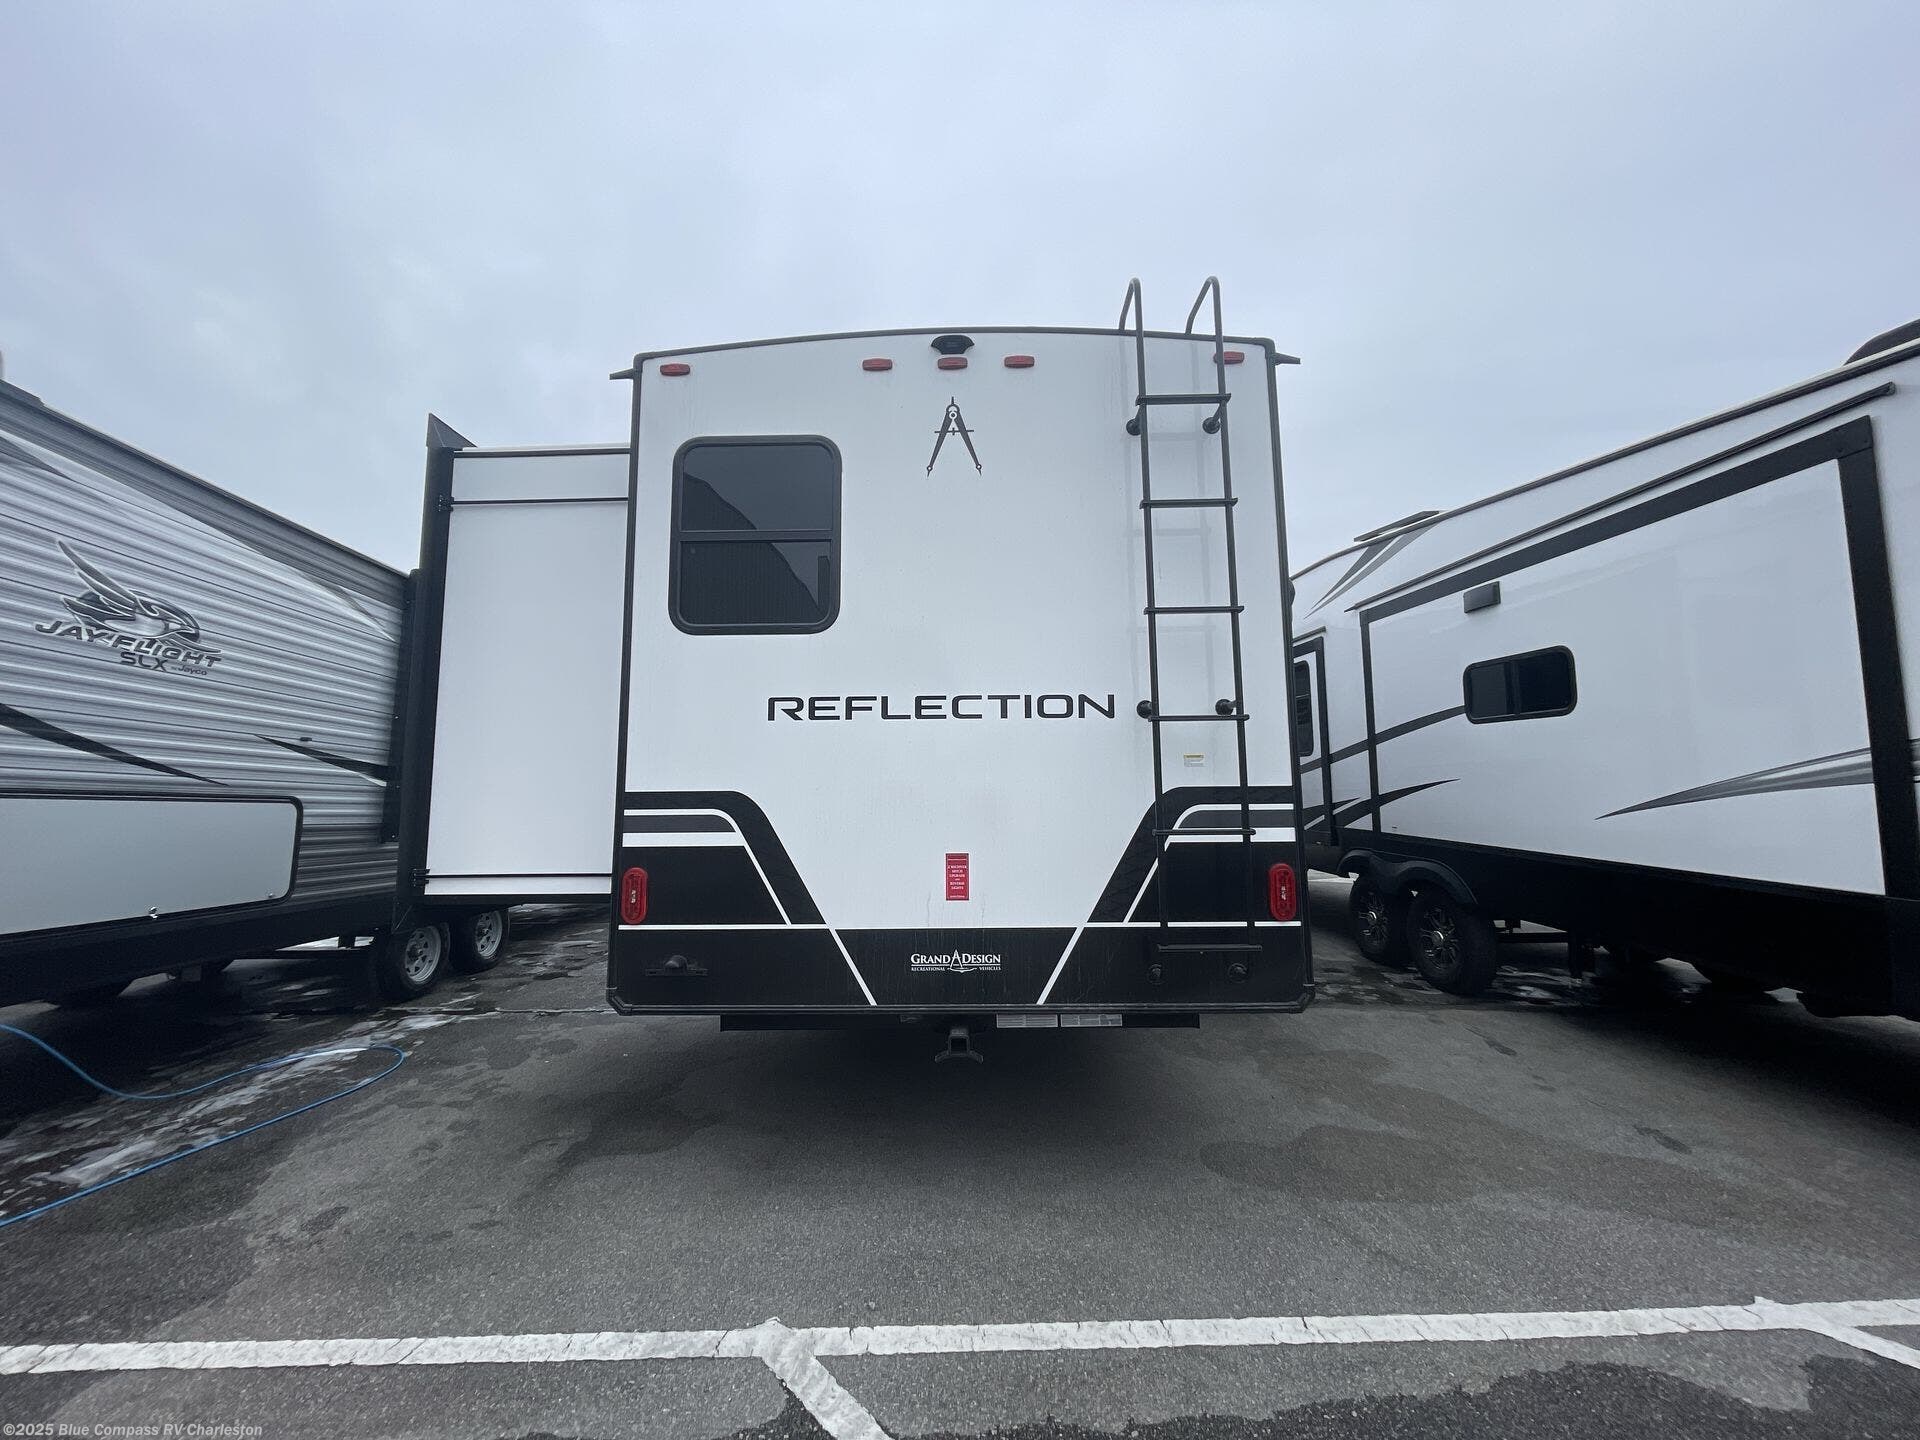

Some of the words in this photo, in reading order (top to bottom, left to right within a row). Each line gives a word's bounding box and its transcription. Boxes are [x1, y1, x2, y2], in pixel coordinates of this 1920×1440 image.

[120, 651, 169, 672] SLX
[178, 664, 208, 676] Jayco
[767, 693, 1115, 721] REFLECTION
[910, 953, 951, 964] GRAND
[961, 953, 1001, 964] DESIGN
